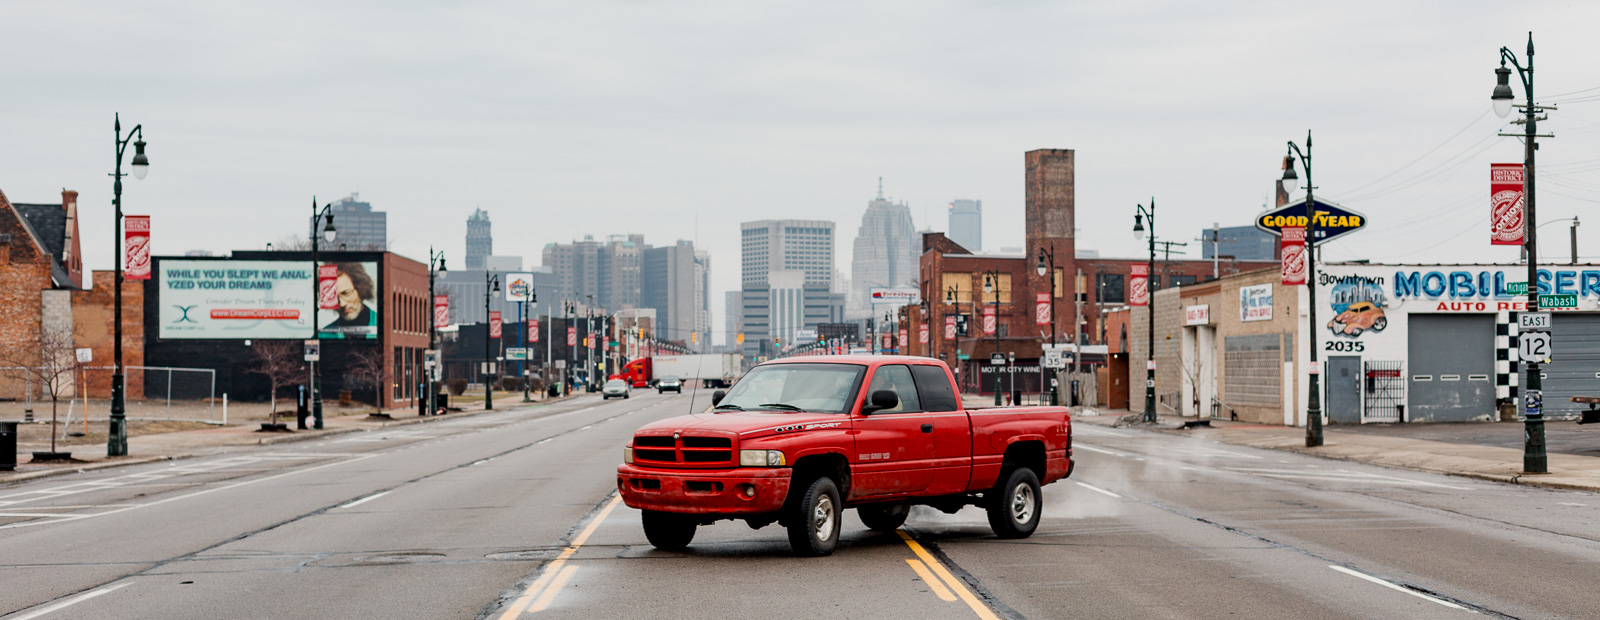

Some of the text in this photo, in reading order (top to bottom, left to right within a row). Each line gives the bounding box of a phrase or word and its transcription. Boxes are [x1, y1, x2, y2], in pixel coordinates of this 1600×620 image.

[167, 270, 200, 278] WHILE
[203, 270, 225, 278] YOU
[227, 270, 259, 278] SLEPT
[261, 270, 279, 279] WE
[280, 271, 312, 279] ANAL-
[1319, 273, 1385, 286] Downtown
[167, 281, 273, 289] YZED YOUR DREAMS
[1393, 271, 1514, 299] MOBIL
[286, 298, 305, 306] Today
[1437, 302, 1486, 311] AUTO
[1541, 297, 1576, 307] Wabash
[212, 310, 299, 318] www.DreamCorpLLC.com
[1523, 316, 1547, 326] EAST
[1325, 341, 1365, 352] 2035
[1526, 338, 1546, 355] 12
[1047, 358, 1060, 366] 35
[805, 422, 841, 430] SPORT
